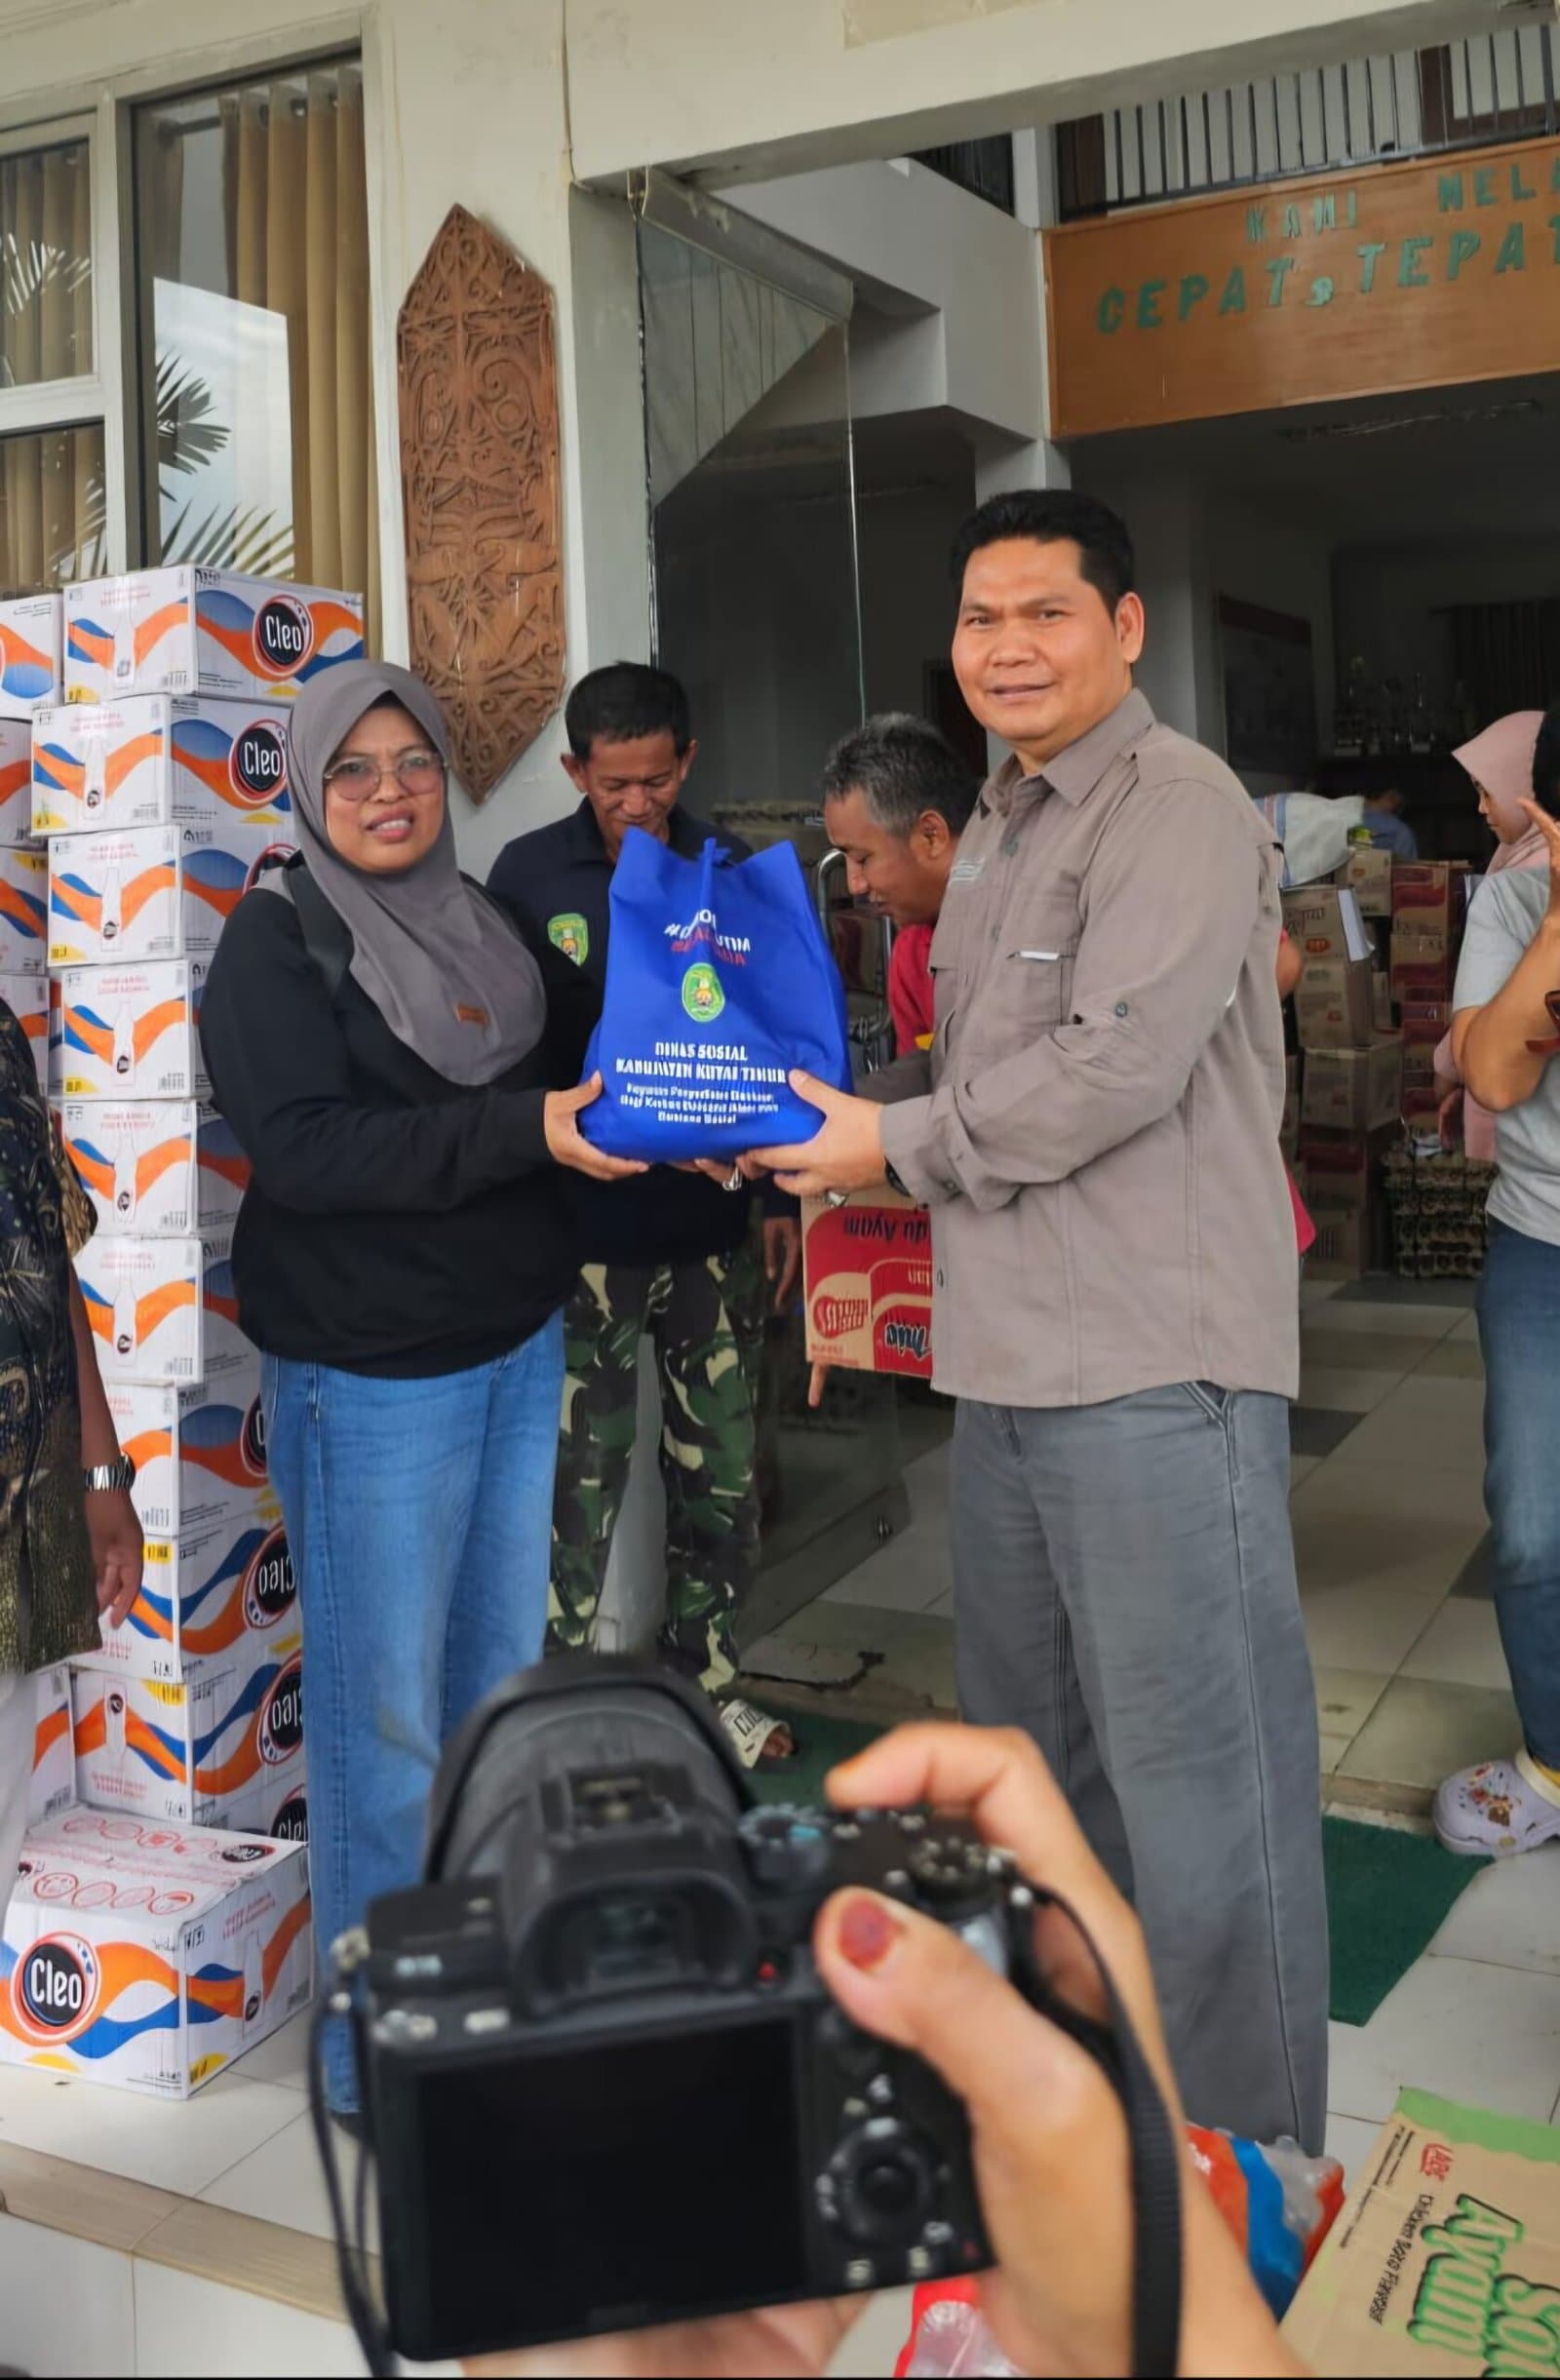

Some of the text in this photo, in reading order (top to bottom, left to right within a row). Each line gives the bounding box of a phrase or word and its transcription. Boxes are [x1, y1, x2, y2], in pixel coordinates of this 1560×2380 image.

[265, 614, 303, 653] Cleo
[244, 740, 282, 778] Cleo
[655, 1041, 749, 1062] DINAS SOSIAL
[278, 1816, 308, 1842] Cle
[30, 1958, 83, 2010] Cleo
[1406, 2192, 1524, 2357] Ayam
